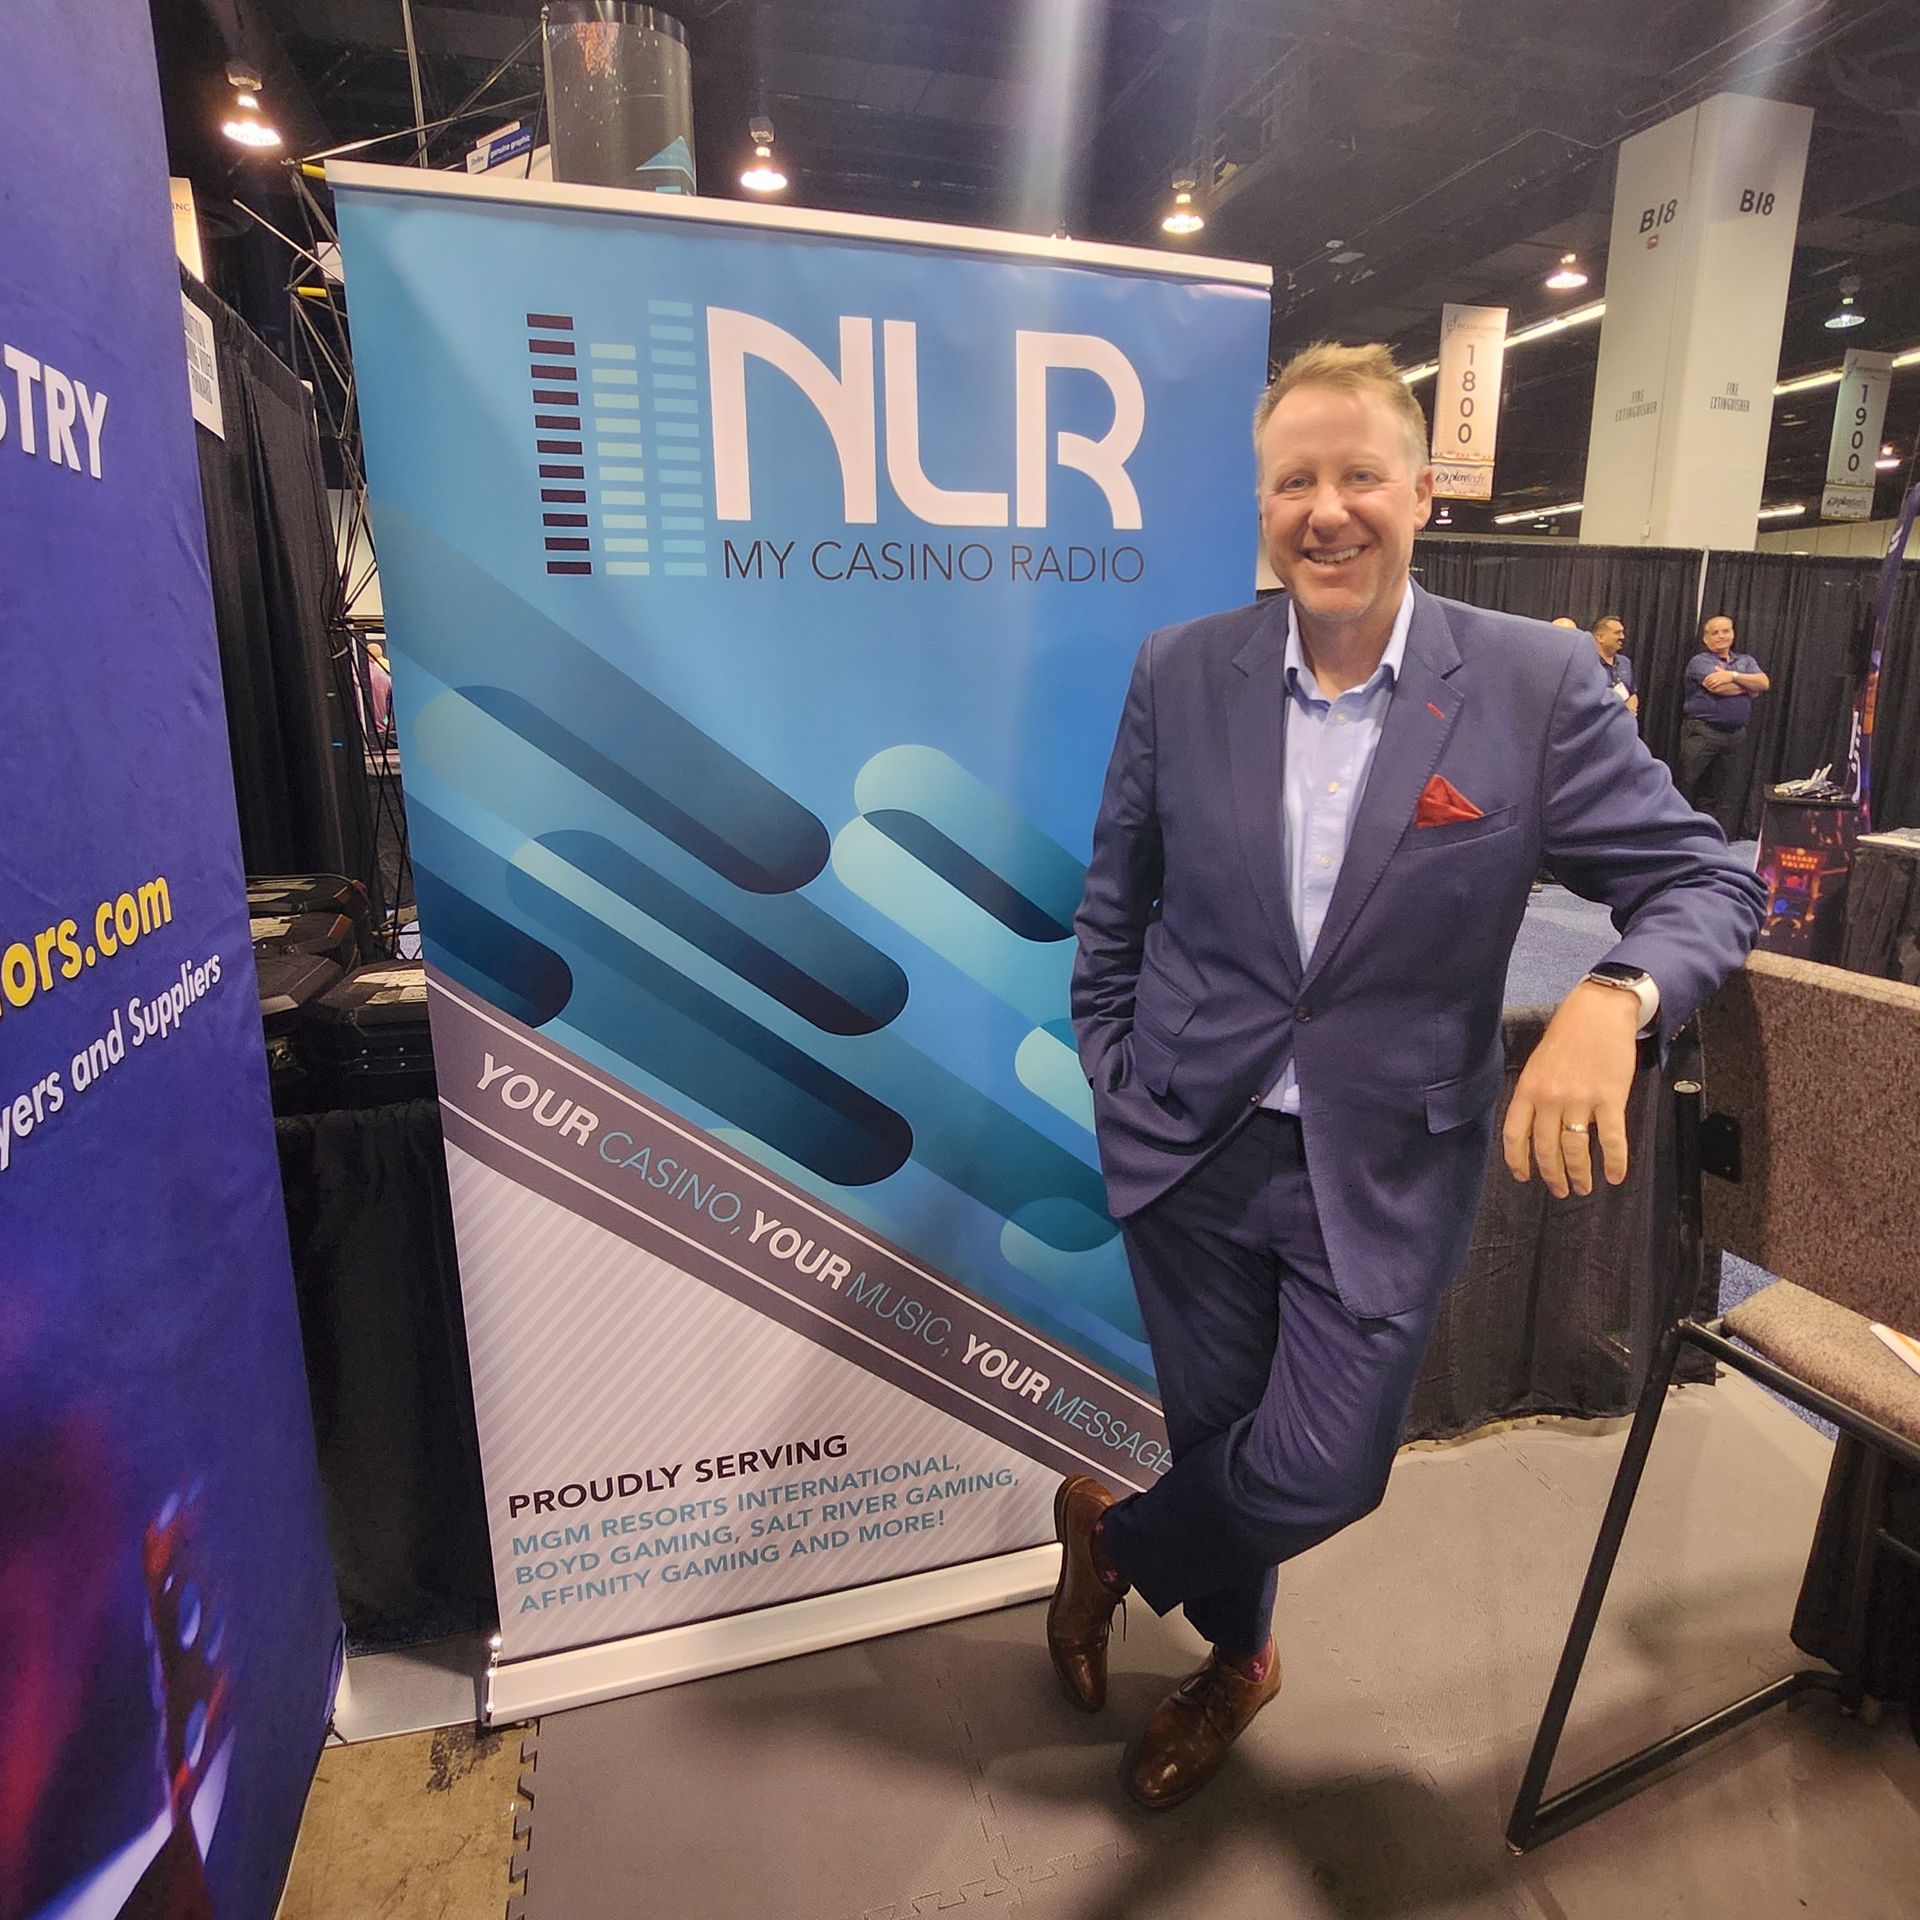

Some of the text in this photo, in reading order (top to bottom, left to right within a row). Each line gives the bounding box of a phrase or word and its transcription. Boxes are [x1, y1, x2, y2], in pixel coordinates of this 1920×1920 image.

[0, 343, 108, 480] TRY
[707, 306, 1145, 530] NLR
[1457, 344, 1476, 444] 1800
[1847, 384, 1868, 472] 1900
[723, 539, 1144, 584] MY CASINO RADIO
[0, 876, 172, 1016] ors.com
[71, 1008, 125, 1092] and
[128, 954, 221, 1038] Suppliers
[476, 1052, 599, 1146] YOUR
[599, 1131, 742, 1236] CASINO,
[748, 1209, 852, 1290] YOUR
[845, 1271, 951, 1357] MUSIC,
[960, 1333, 1051, 1404] YOUR
[508, 1435, 848, 1519] PROUDLY SERVING
[512, 1454, 961, 1556] MGM RESORTS INTERNATIONAL,
[515, 1468, 1020, 1585] BOYD GAMING, SALT RIVER GAMING,
[519, 1509, 945, 1614] AFFINITY GAMING AND MORE!
